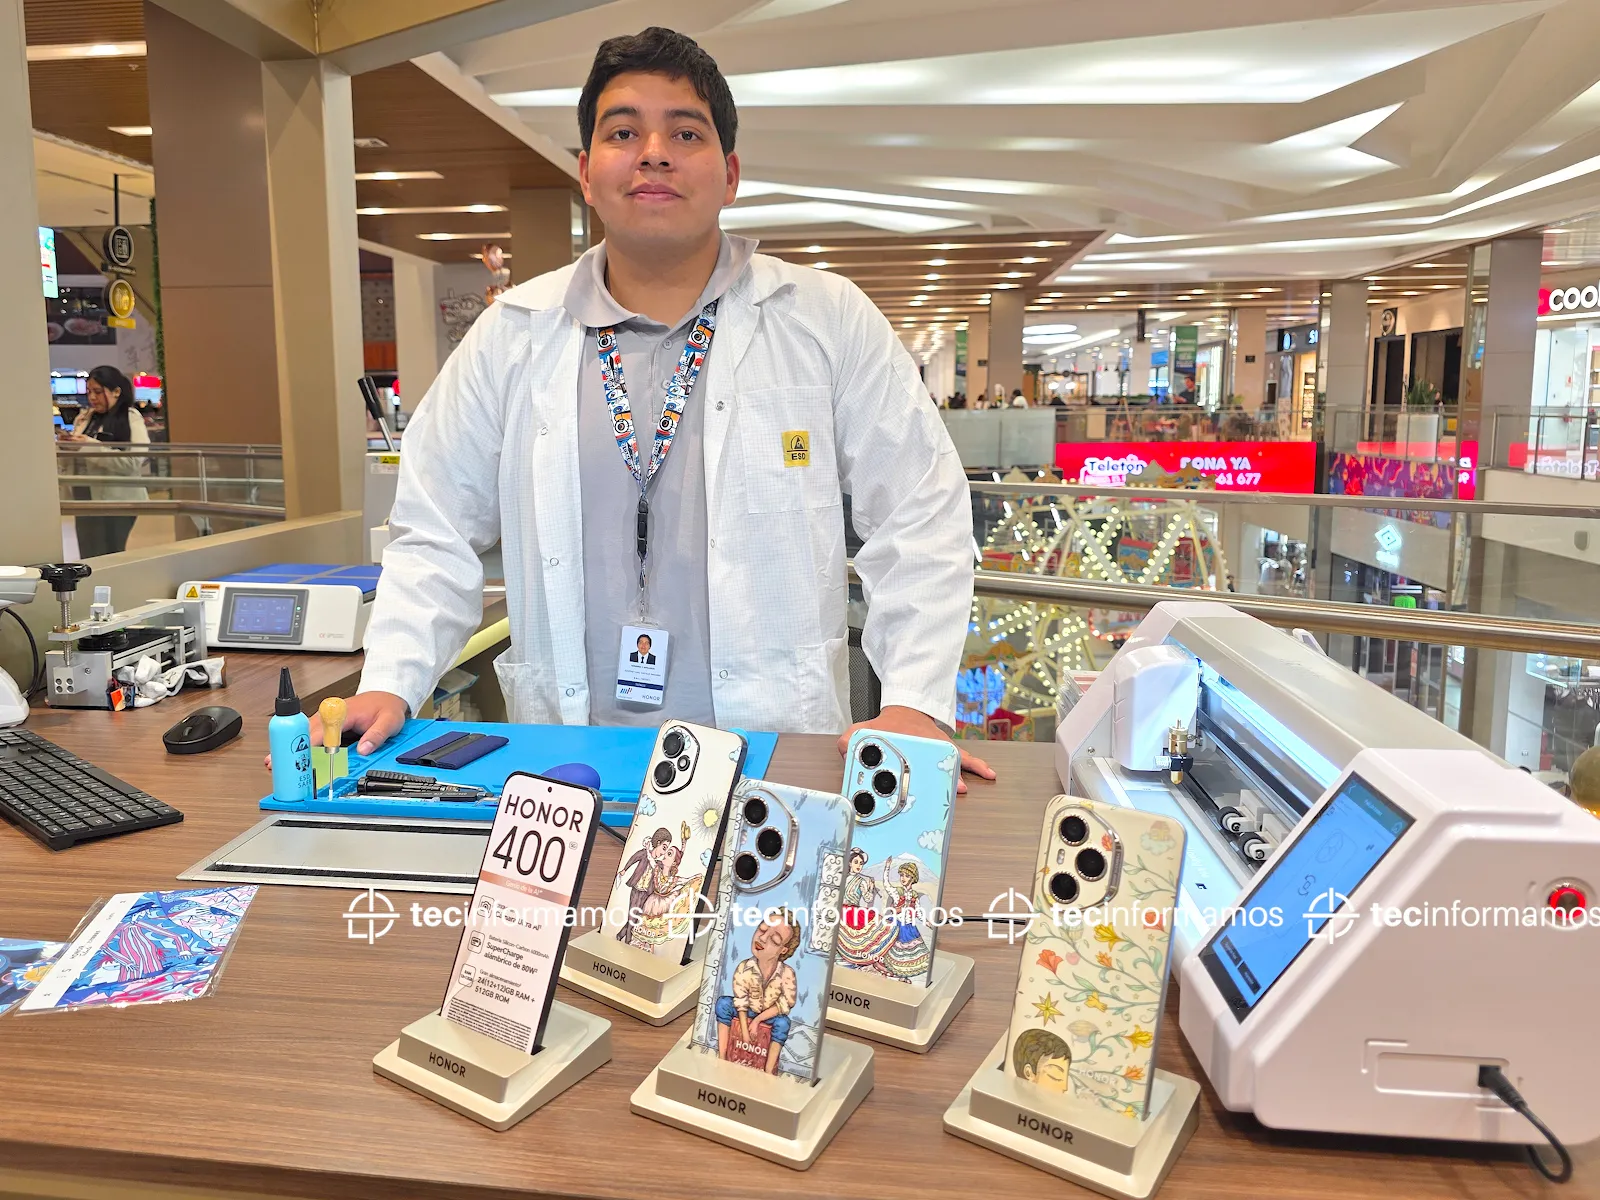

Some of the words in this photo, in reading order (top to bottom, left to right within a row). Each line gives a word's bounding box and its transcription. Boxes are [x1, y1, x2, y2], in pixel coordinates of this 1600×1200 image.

[791, 453, 806, 461] ESD
[1230, 457, 1251, 470] YA
[1236, 472, 1261, 485] 677
[300, 774, 311, 782] ESD
[504, 794, 584, 833] HONOR
[492, 825, 566, 883] 400
[633, 925, 656, 937] HONOR
[483, 951, 512, 967] alámbrico
[512, 961, 521, 970] de
[486, 941, 524, 961] SuperCharge
[856, 950, 884, 963] HONOR
[592, 961, 627, 983] HONOR
[474, 985, 494, 998] 512GB
[494, 993, 511, 1005] ROM
[477, 976, 515, 996] 24(12+12)GB
[514, 989, 531, 1002] RAM
[735, 1040, 768, 1058] HONOR
[428, 1051, 466, 1078] HONOR
[697, 1088, 747, 1115] HONOR
[1017, 1113, 1074, 1146] HONOR
